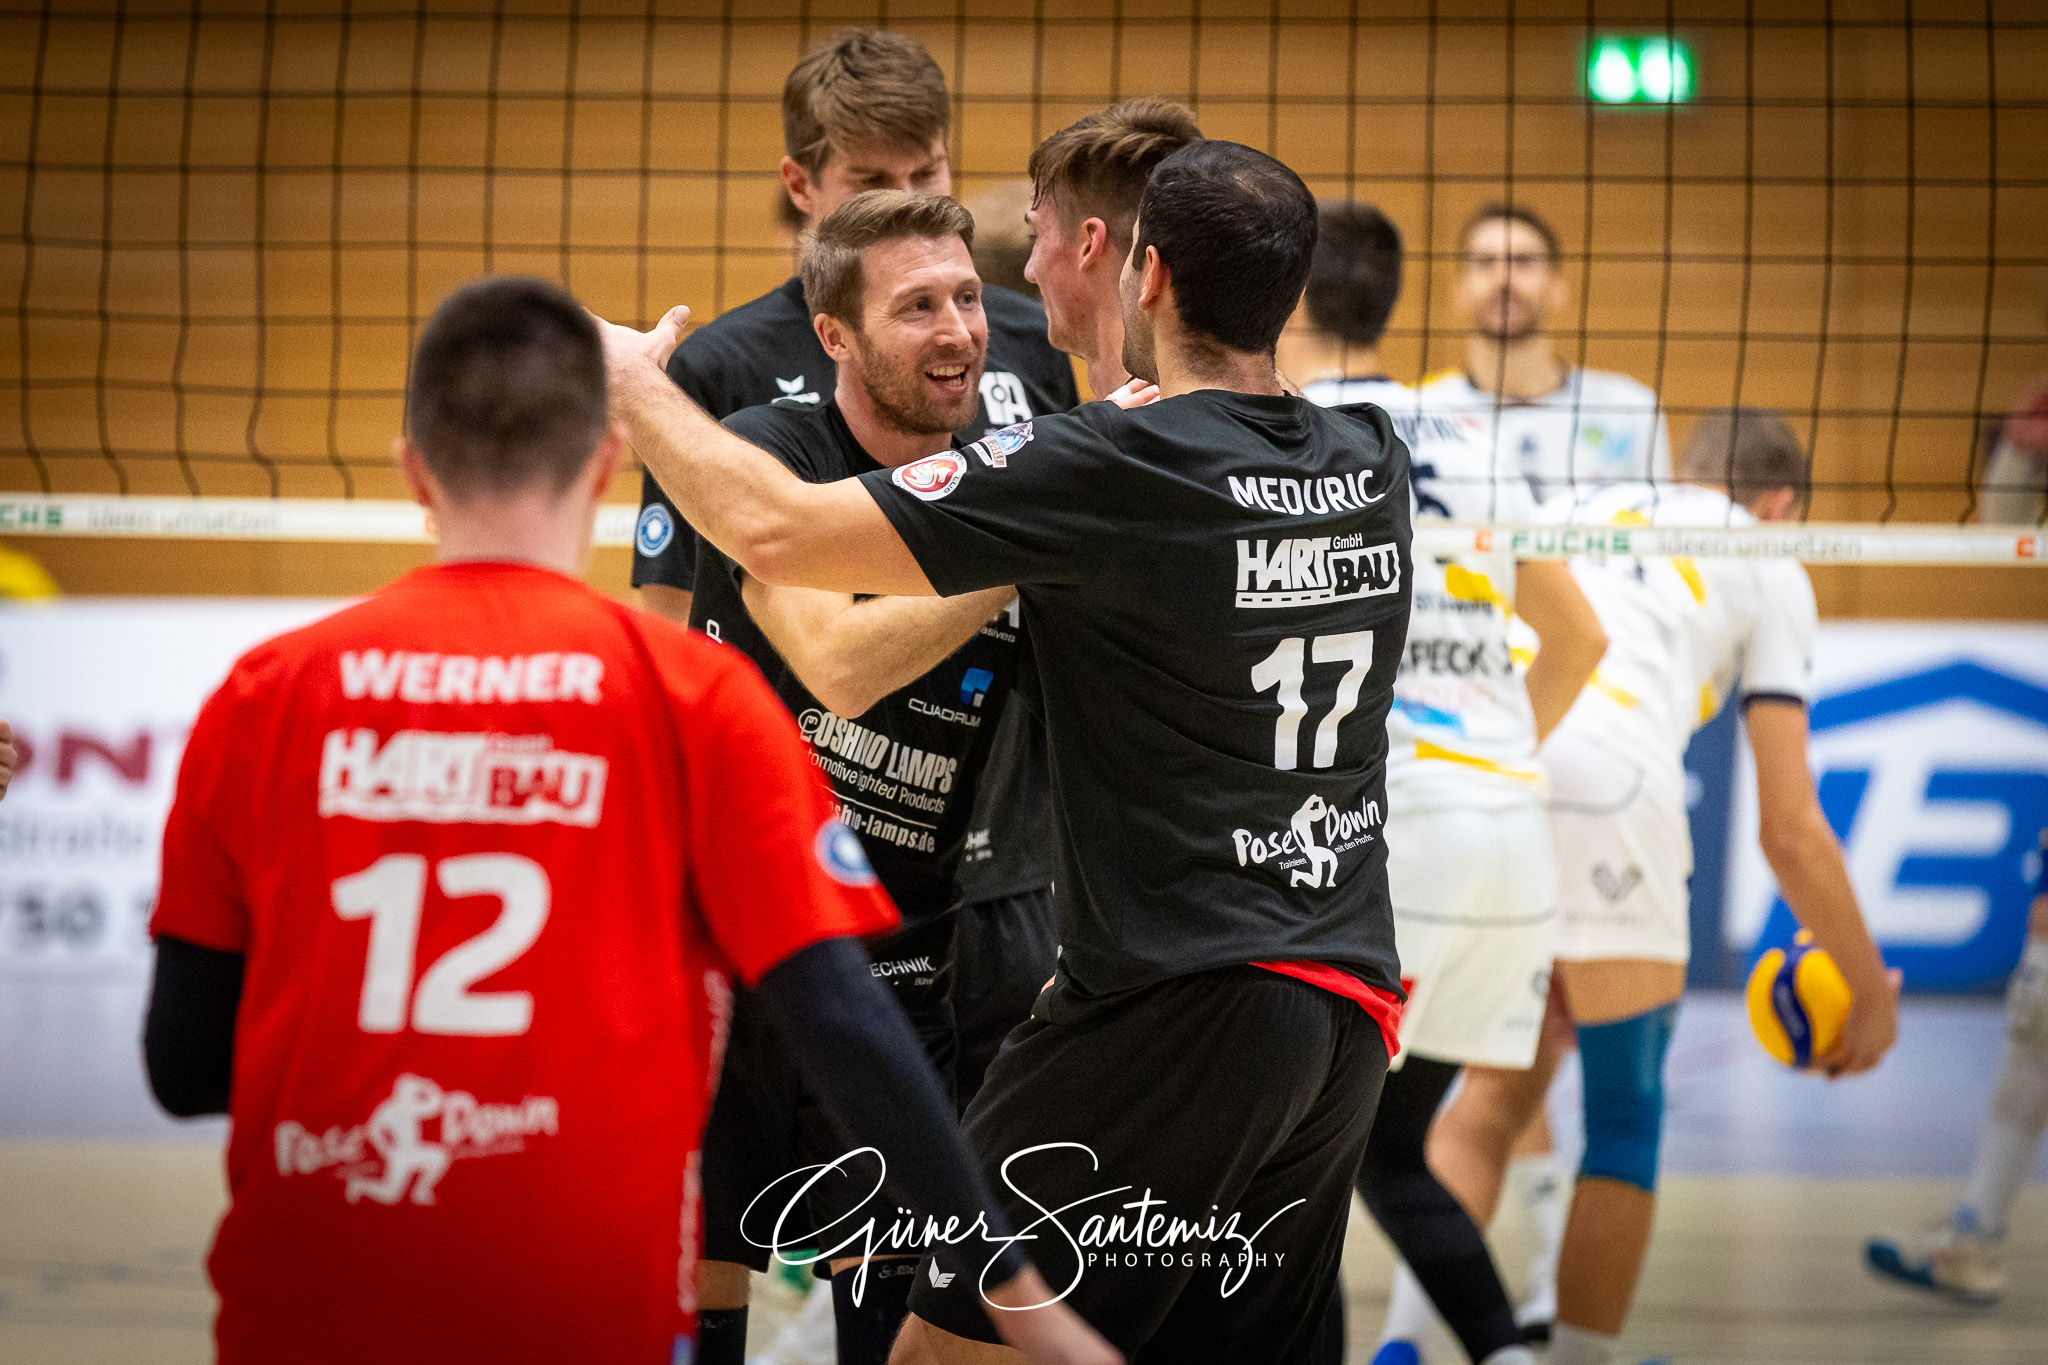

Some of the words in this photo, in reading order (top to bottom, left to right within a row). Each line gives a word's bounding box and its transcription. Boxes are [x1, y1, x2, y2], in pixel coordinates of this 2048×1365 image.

[1228, 469, 1386, 516] MEDURIC
[1236, 537, 1331, 590] HART
[1333, 533, 1363, 550] GmbH
[1511, 529, 1632, 555] FUCHS
[1332, 551, 1397, 597] BAU
[340, 648, 604, 705] WERNER
[1251, 630, 1374, 771] 17
[319, 728, 490, 806] HART
[885, 742, 957, 794] LAMPS
[898, 786, 946, 814] Products
[1232, 829, 1297, 867] Pose
[1325, 796, 1382, 846] Down
[1279, 857, 1308, 870] Trainieren
[1345, 840, 1356, 850] den
[330, 852, 553, 1037] 12
[869, 955, 937, 978] ECHNIK.
